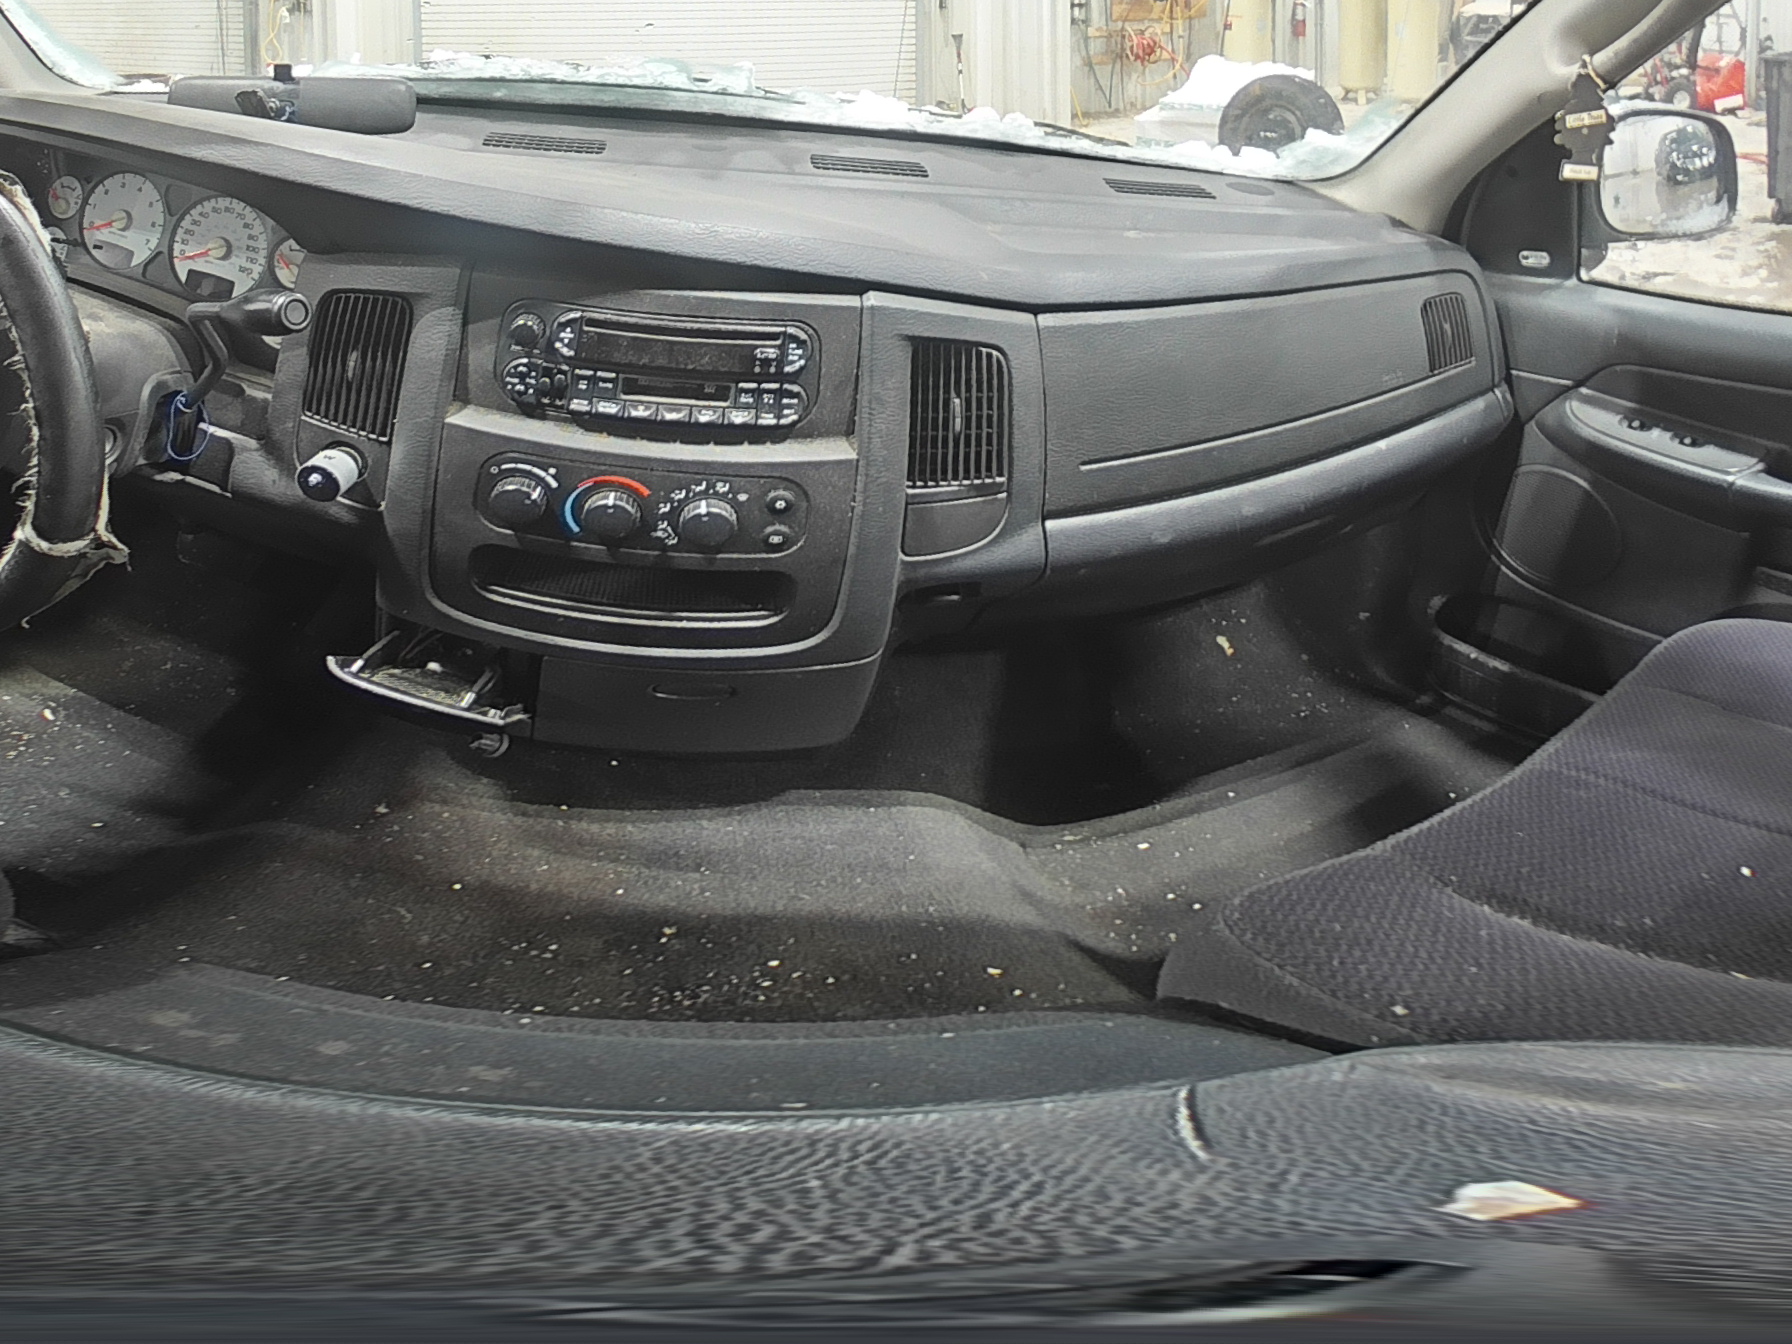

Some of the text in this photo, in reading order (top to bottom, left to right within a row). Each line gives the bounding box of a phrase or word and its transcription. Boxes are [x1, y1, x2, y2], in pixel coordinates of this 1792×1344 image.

[211, 206, 222, 214] 50
[198, 211, 210, 219] 40
[235, 212, 246, 221] 70
[181, 238, 189, 246] 10
[246, 245, 260, 253] 100
[245, 256, 258, 265] 110
[238, 265, 253, 275] 120
